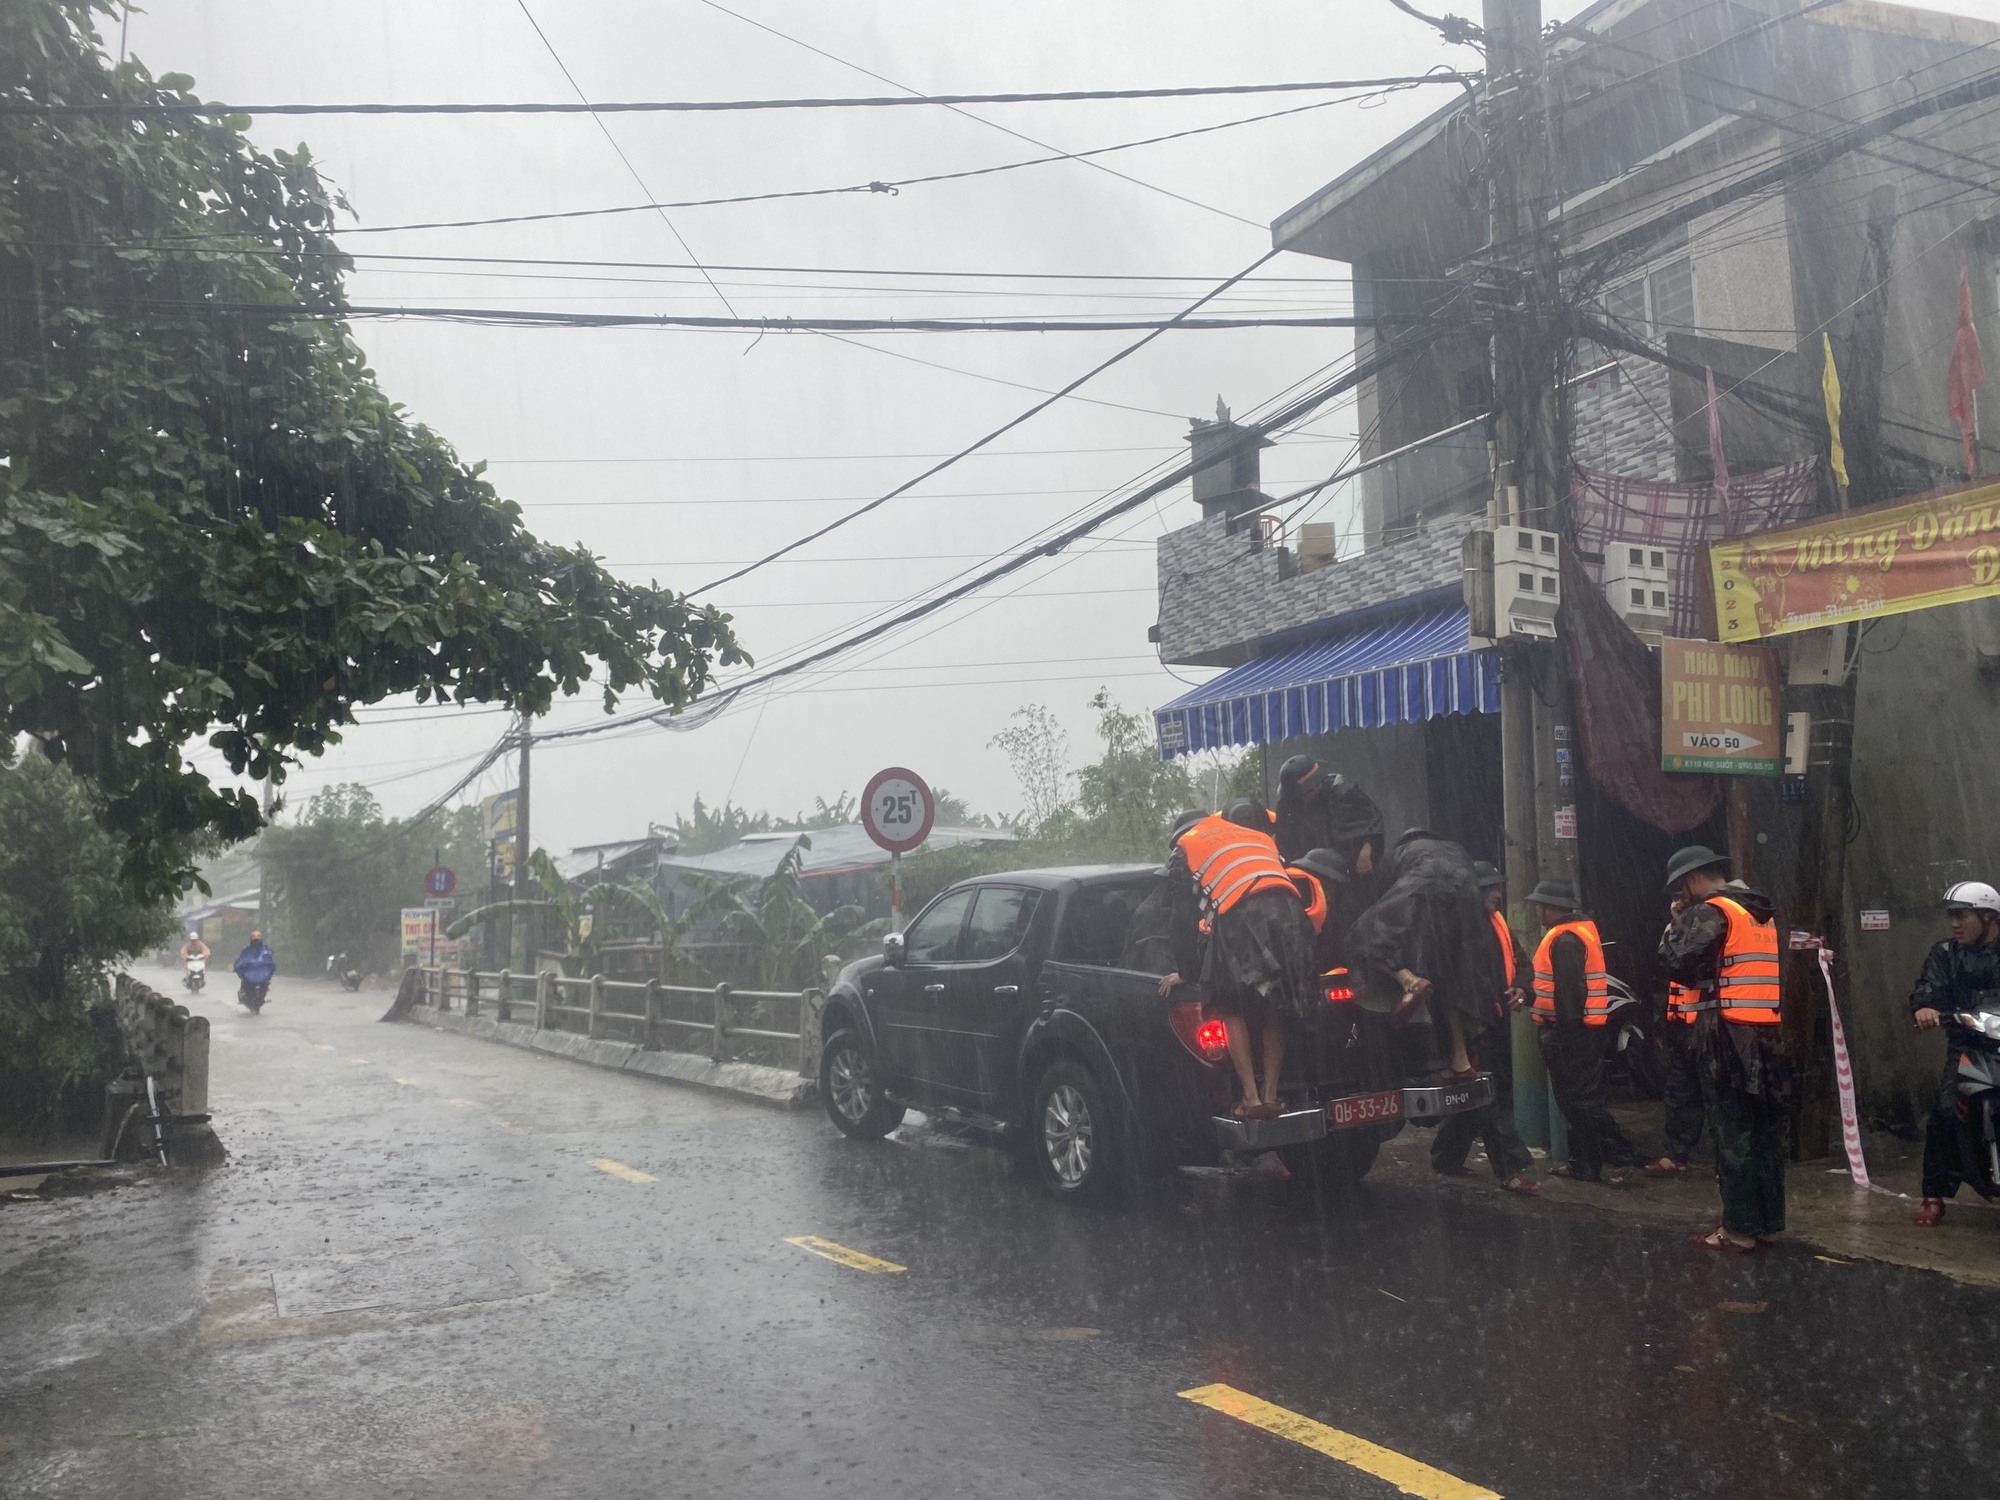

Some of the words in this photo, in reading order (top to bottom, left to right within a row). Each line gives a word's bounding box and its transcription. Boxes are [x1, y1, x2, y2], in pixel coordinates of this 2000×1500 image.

[1907, 504, 2000, 550] Đản
[1672, 680, 1712, 723] PHI
[1720, 684, 1773, 726] LONG
[1690, 733, 1720, 748] VÀO
[1724, 738, 1740, 748] 50
